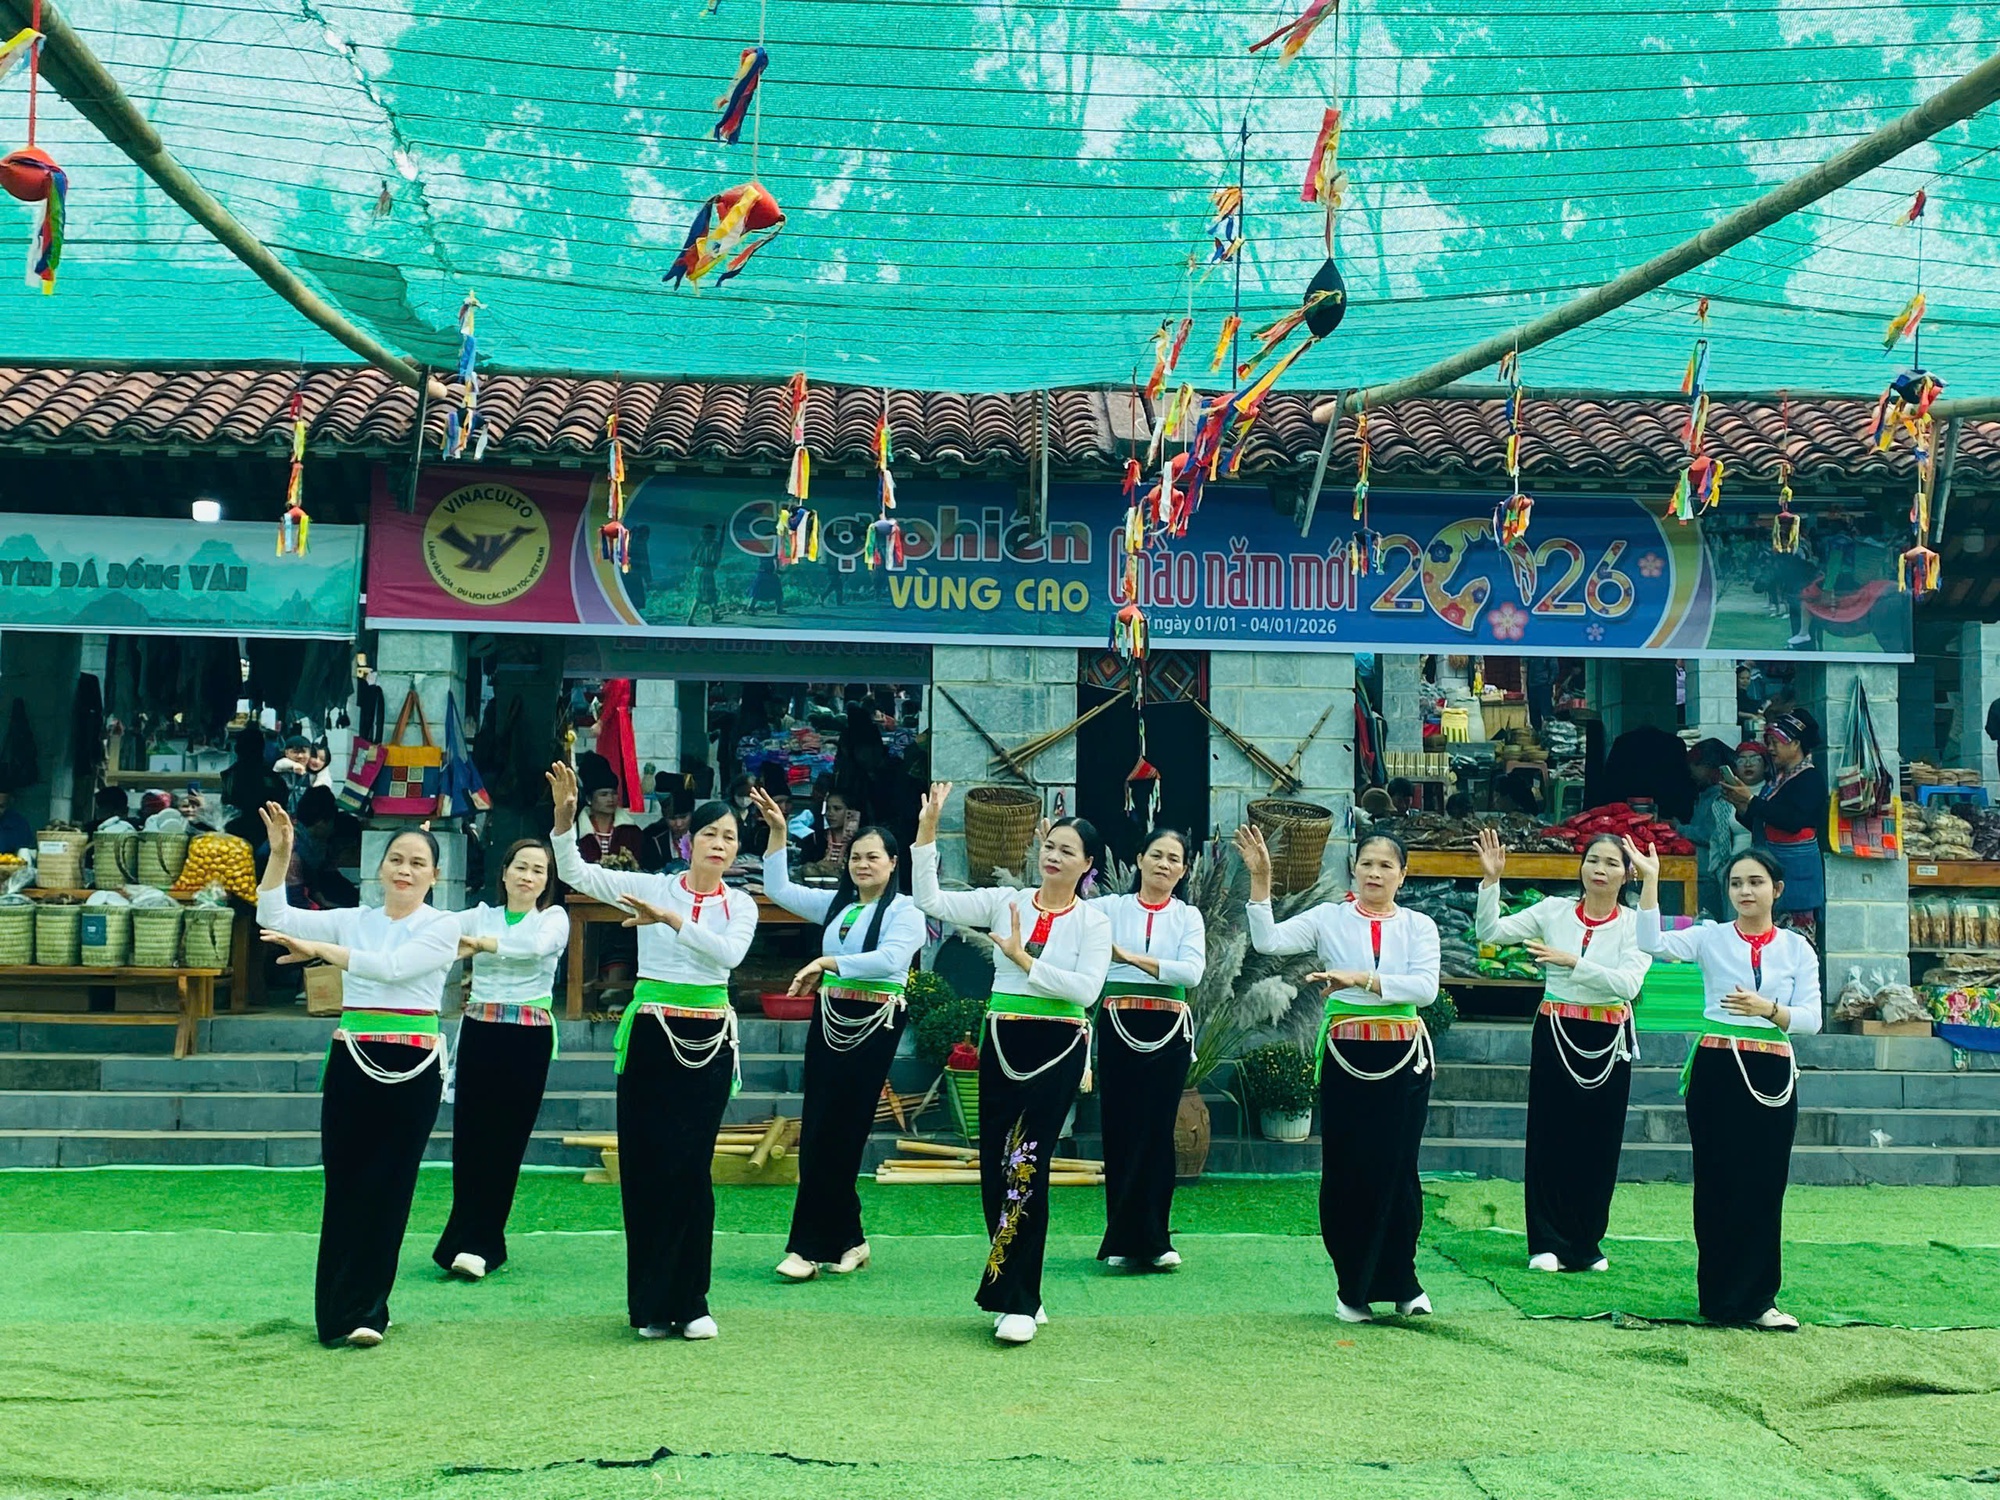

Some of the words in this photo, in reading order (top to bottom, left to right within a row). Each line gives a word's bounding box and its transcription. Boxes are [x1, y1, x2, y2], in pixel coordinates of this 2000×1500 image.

[443, 488, 533, 518] VINACULTO
[59, 557, 100, 588] ĐÁ
[1202, 535, 1284, 610] năm
[1289, 536, 1358, 612] mới
[457, 588, 468, 596] DU
[468, 592, 486, 600] LỊCH
[486, 591, 501, 600] CÁC
[501, 586, 518, 597] DÂN
[888, 567, 1002, 612] VÙNG
[1014, 578, 1090, 613] CAO
[1154, 614, 1192, 635] ngày
[1194, 616, 1236, 632] 01/01
[1250, 617, 1337, 635] 04/01/2026
